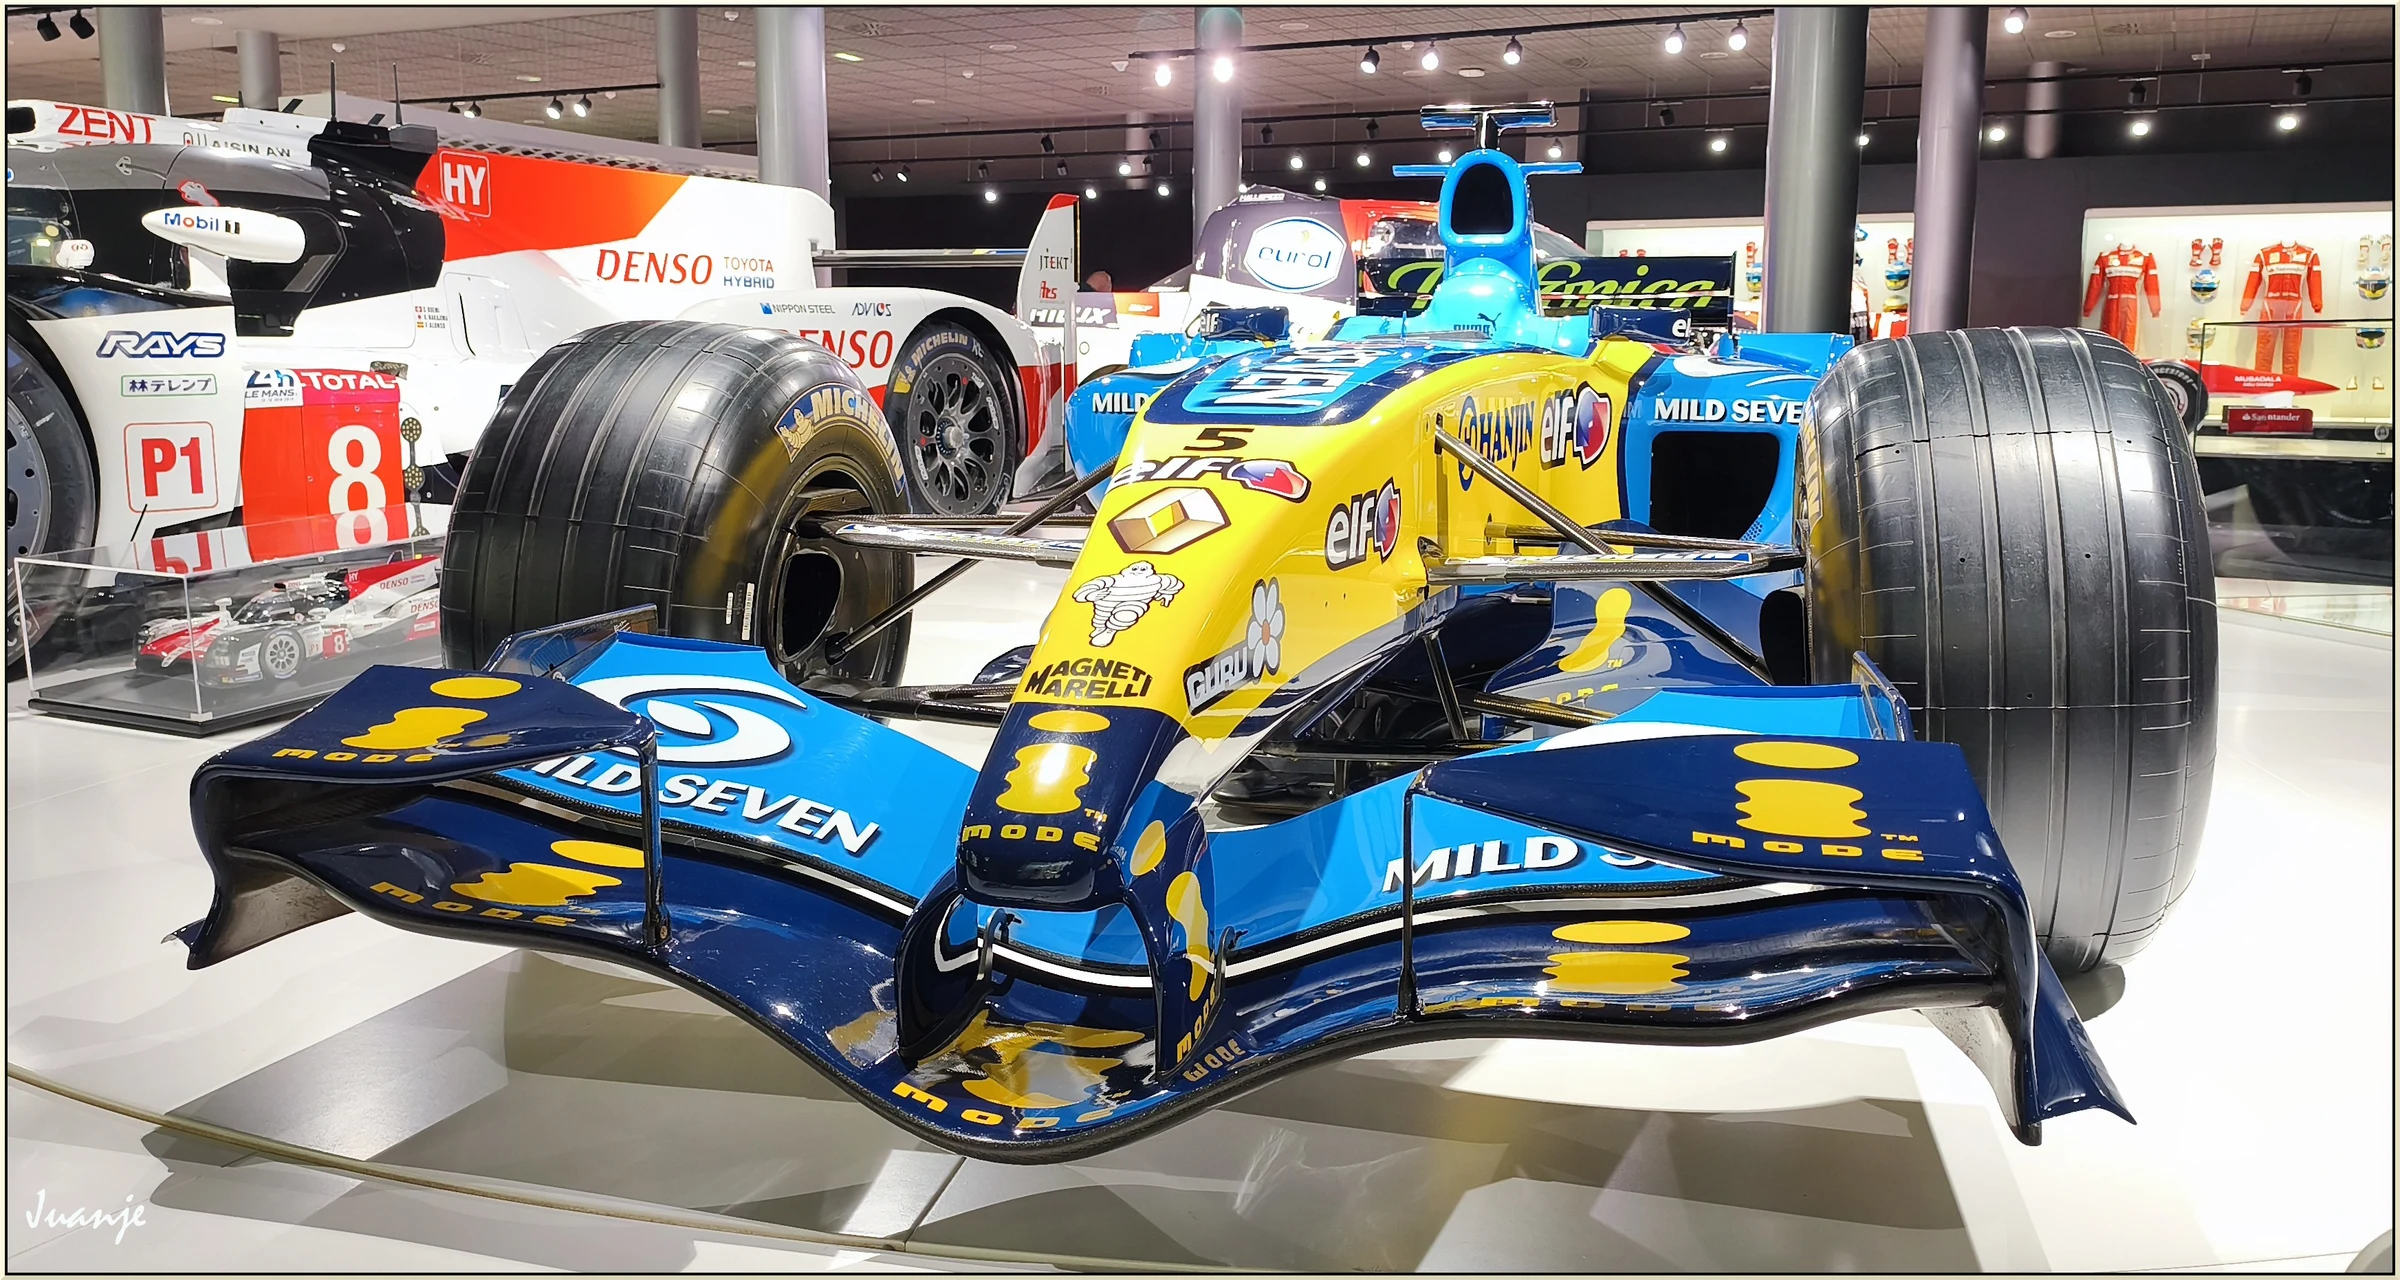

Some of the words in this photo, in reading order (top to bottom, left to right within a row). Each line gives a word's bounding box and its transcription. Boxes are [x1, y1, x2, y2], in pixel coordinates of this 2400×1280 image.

[55, 104, 157, 143] ZENT
[266, 146, 291, 158] AW
[443, 164, 486, 206] HY
[164, 213, 219, 232] Mobil
[597, 248, 713, 285] DENSO
[723, 256, 775, 273] TOYOTA
[1039, 254, 1069, 271] JTEKT
[1258, 246, 1332, 269] eurol
[723, 276, 776, 289] HYBRID
[773, 303, 807, 314] NIPPON
[808, 305, 836, 315] STEEL
[851, 302, 892, 317] ADVICS
[97, 331, 225, 359] RAYS
[780, 329, 893, 368] NSO
[911, 331, 968, 367] MICHELIN
[128, 378, 213, 392] 林テレンプ
[300, 371, 396, 391] TOTAL
[245, 390, 259, 399] LE
[261, 388, 295, 398] MANS
[1654, 398, 1727, 421] MILD
[1731, 399, 1807, 423] SEVE
[2251, 411, 2300, 422] Santander
[810, 387, 905, 481] MICHELIN
[1183, 427, 1255, 451] 5
[1479, 400, 1535, 472] HANJIN
[141, 436, 204, 498] P1
[327, 425, 387, 514] 8
[1326, 496, 1376, 566] elf
[380, 578, 409, 590] DENSO
[334, 634, 344, 653] 8
[1187, 650, 1248, 706] GURU
[531, 754, 641, 794] ILD
[660, 773, 880, 853] SEVEN
[1881, 833, 1919, 842] TM
[1382, 835, 1580, 893] MILD
